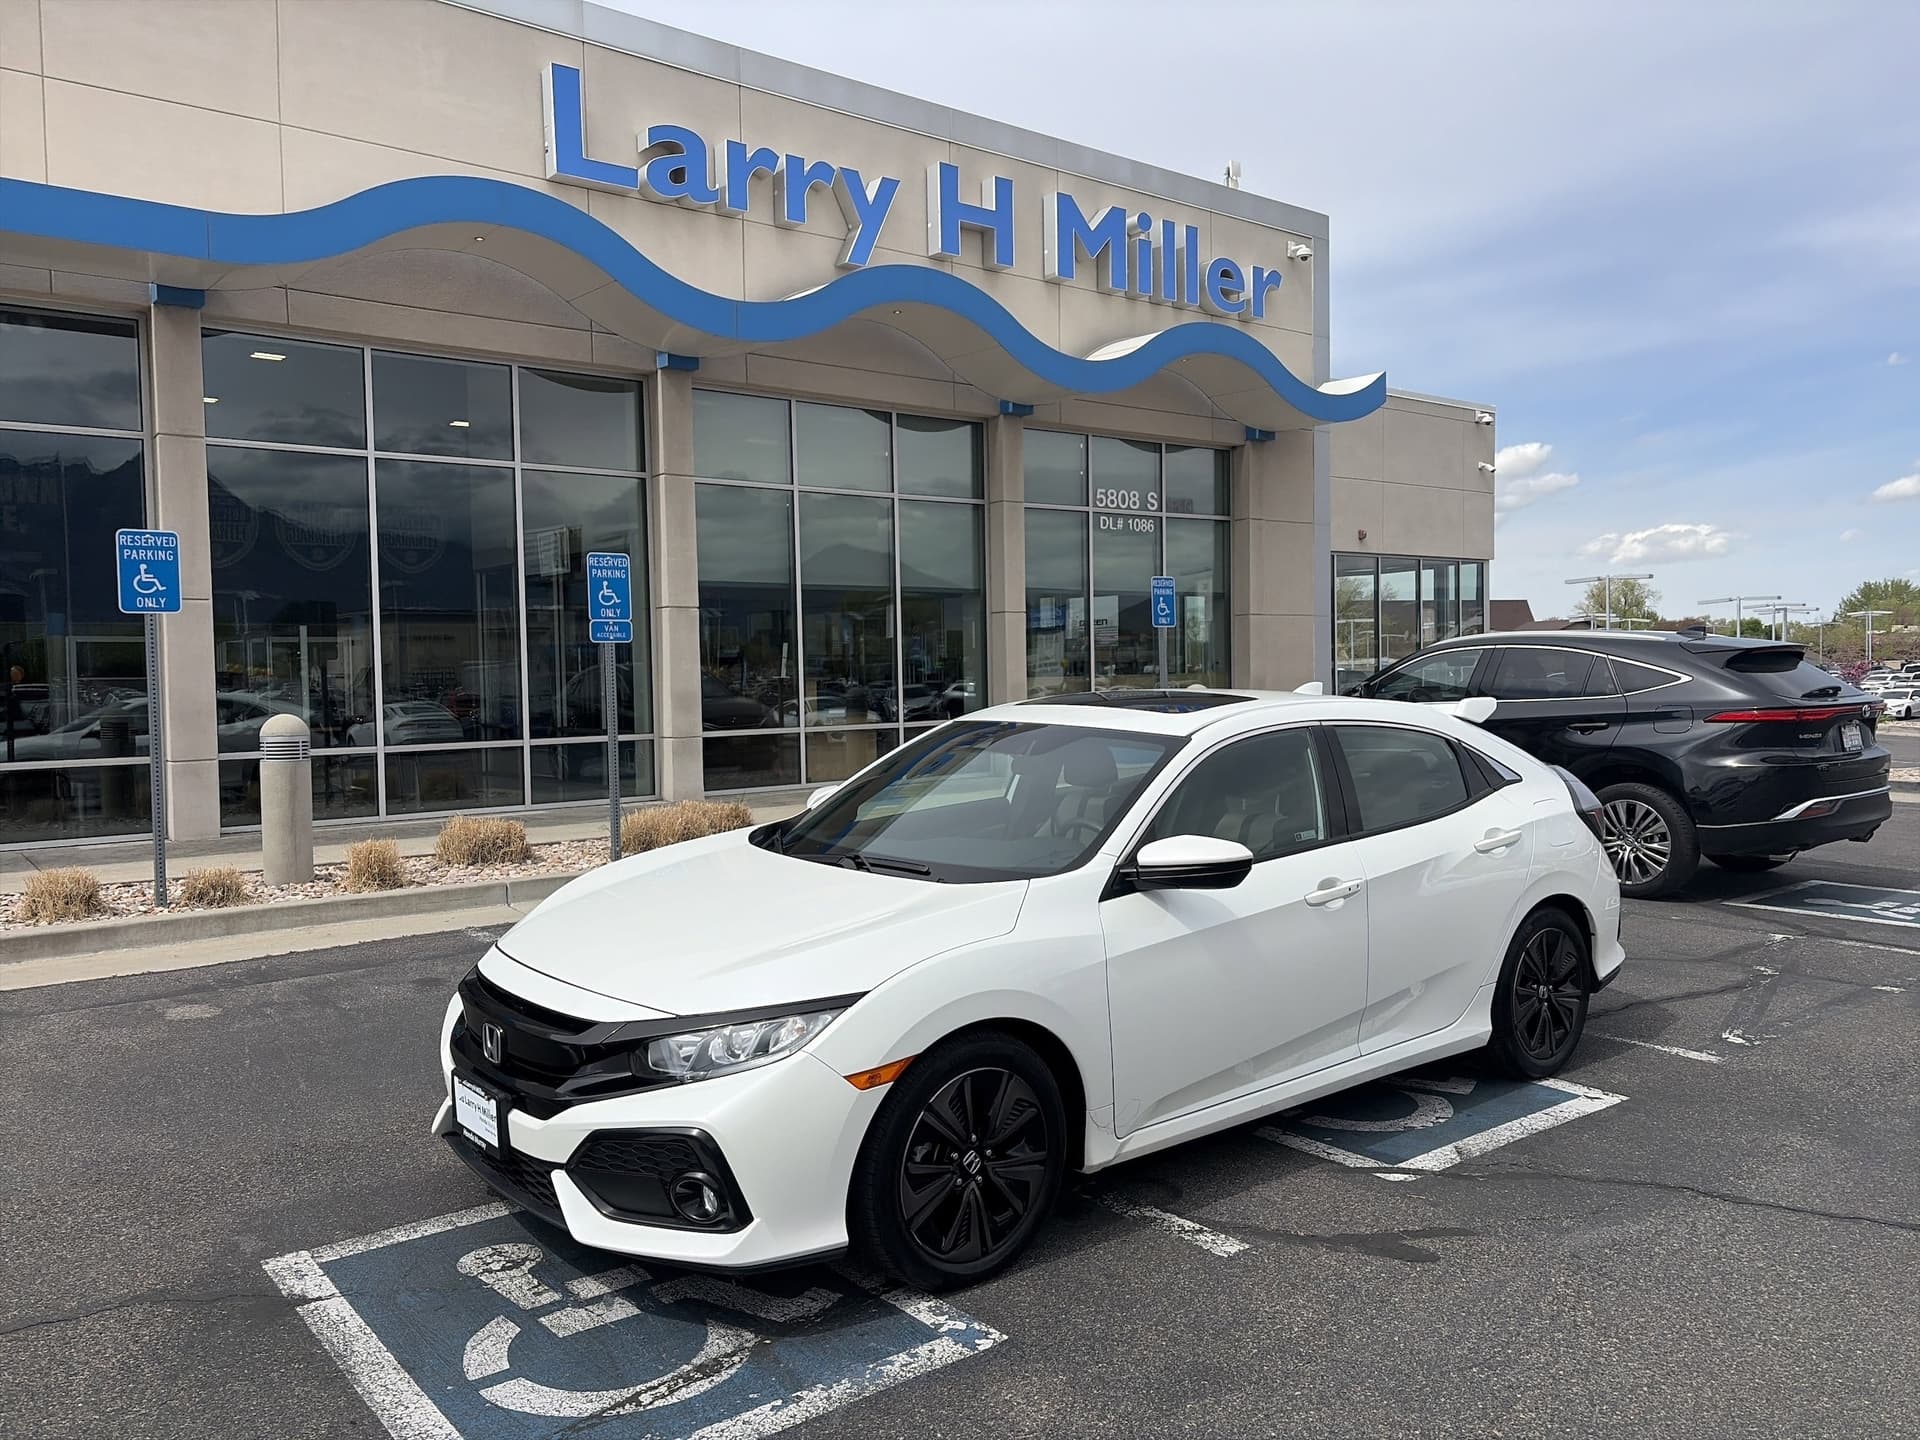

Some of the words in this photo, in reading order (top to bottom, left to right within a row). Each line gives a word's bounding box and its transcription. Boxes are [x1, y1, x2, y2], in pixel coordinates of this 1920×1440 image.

[546, 62, 900, 266] Larry
[932, 160, 1016, 269] H
[1050, 191, 1282, 320] Miller
[1096, 488, 1140, 509] 5808
[1147, 492, 1158, 511] S
[1100, 516, 1124, 530] DL#
[1128, 518, 1154, 532] 1086
[119, 534, 176, 547] RESERVED
[123, 549, 174, 561] PARKING
[589, 557, 628, 567] RESERVED
[591, 568, 626, 578] PARKING
[1153, 587, 1173, 595] PARKING
[136, 597, 166, 608] ONLY
[600, 608, 621, 617] ONLY
